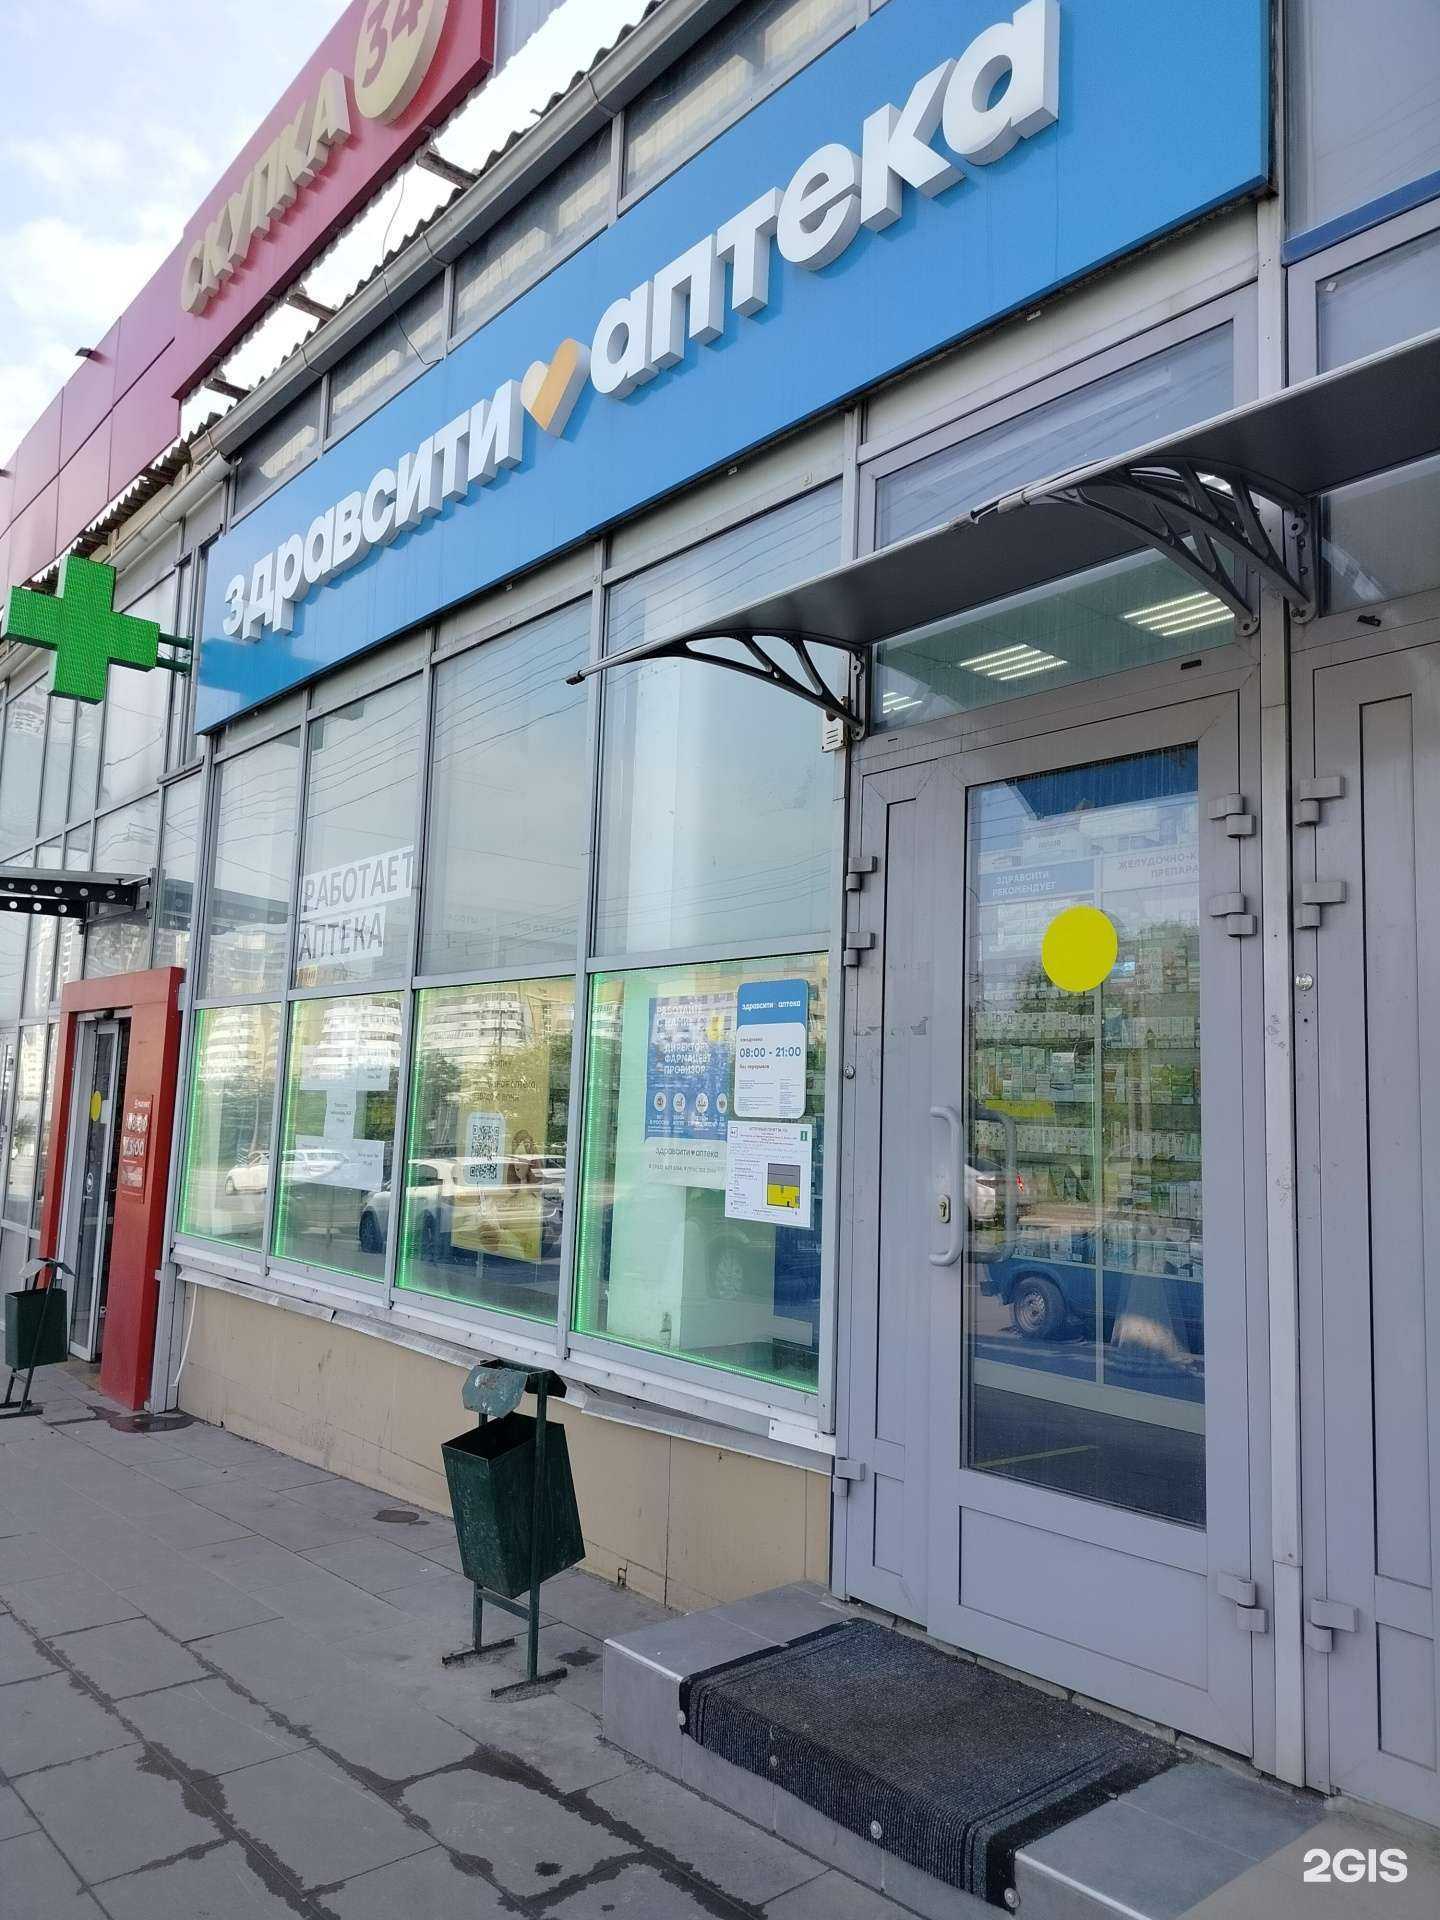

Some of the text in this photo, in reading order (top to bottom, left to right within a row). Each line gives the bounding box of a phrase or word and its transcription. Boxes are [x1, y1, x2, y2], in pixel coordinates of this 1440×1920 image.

[181, 0, 422, 317] СКУПКА 34
[590, 0, 1060, 400] аптека
[303, 850, 415, 912] РАБОТАЕТ
[992, 881, 1057, 897] РЕКОМЕНДУЕТ
[996, 870, 1049, 885] ЗДРАВСИТИ
[298, 912, 383, 961] АПТЕКА
[739, 1047, 766, 1058] 08:00
[775, 1046, 801, 1057] 21:00
[663, 1065, 706, 1076] ПРОВИЗОР
